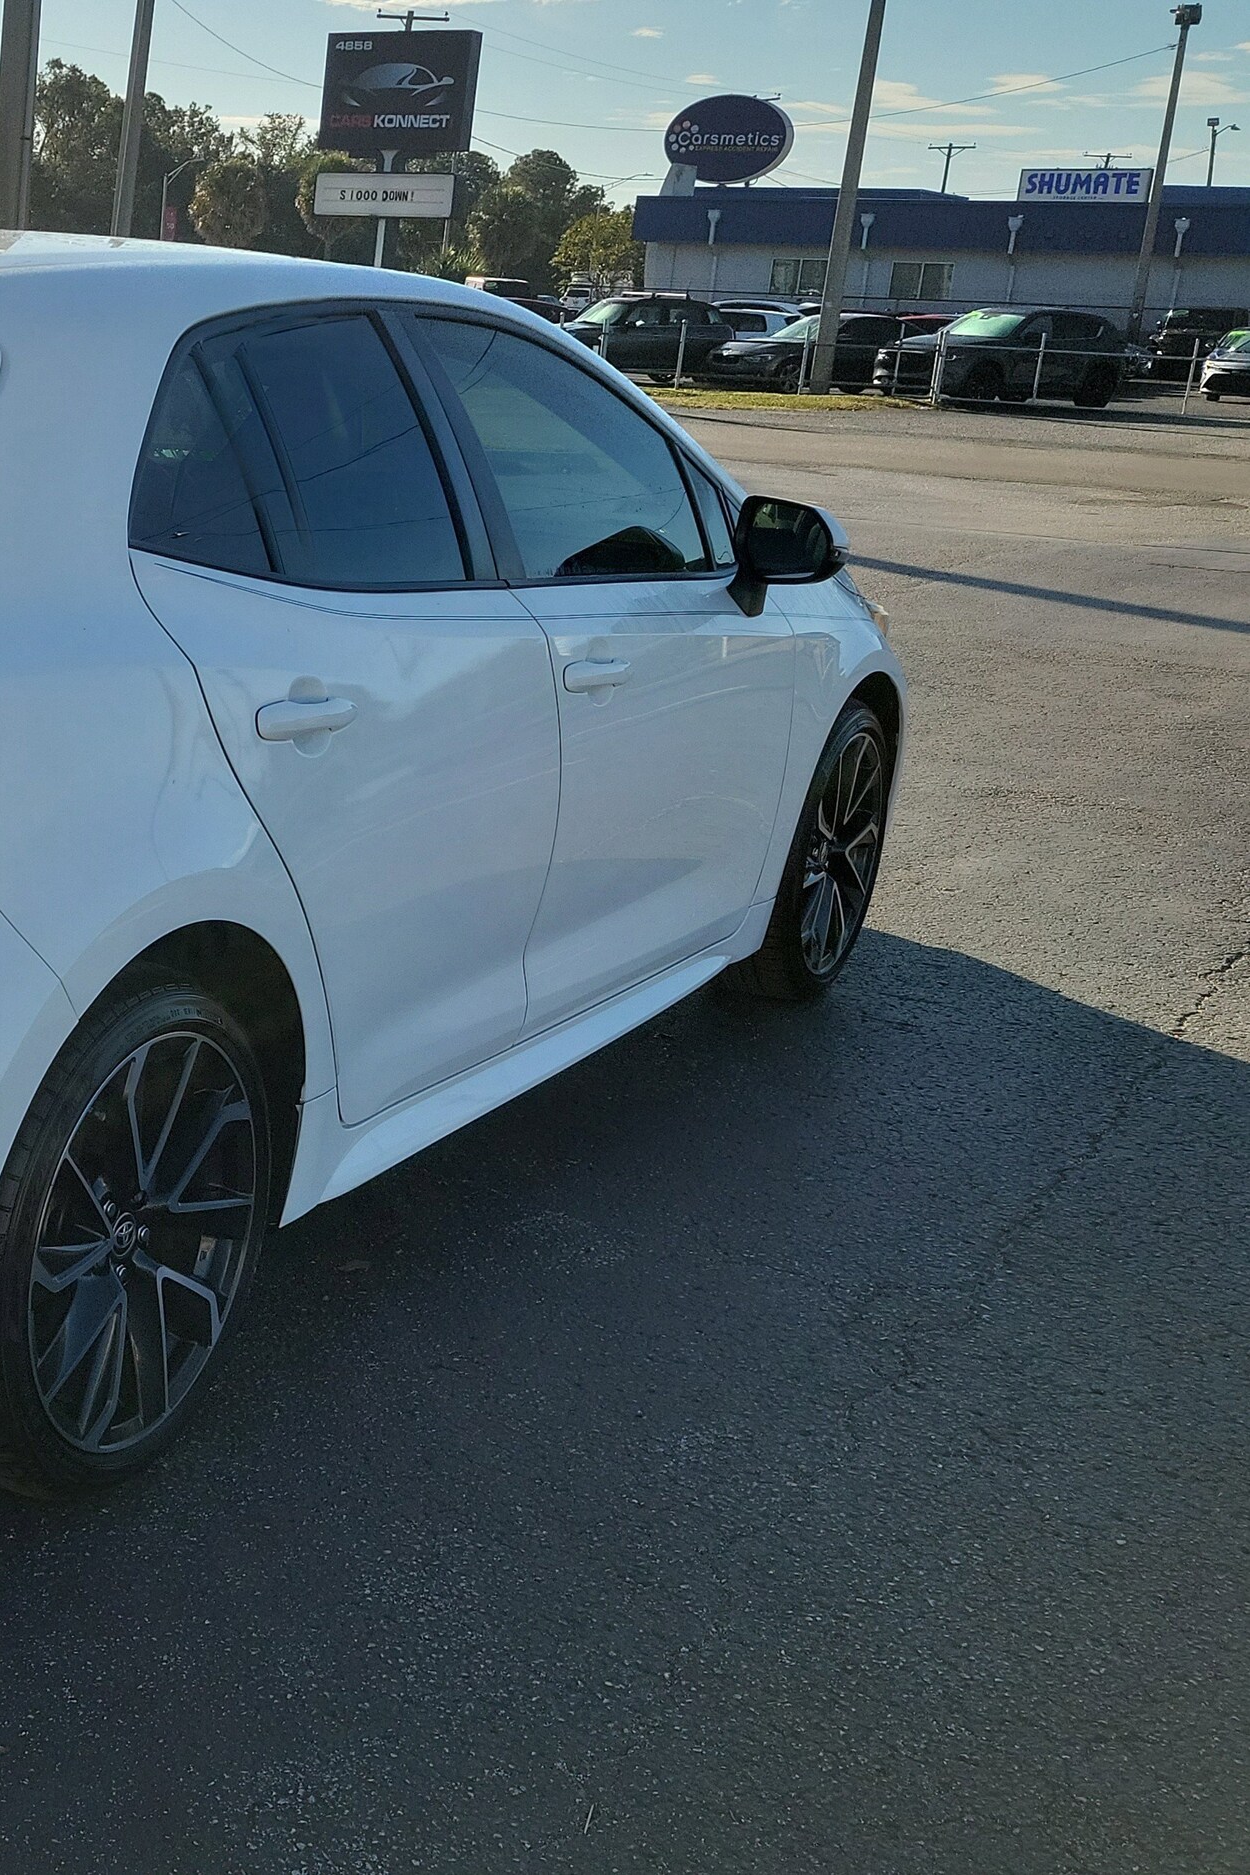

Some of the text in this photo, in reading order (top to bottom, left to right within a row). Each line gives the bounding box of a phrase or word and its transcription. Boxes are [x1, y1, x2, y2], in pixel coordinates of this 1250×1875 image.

[335, 40, 373, 51] 4858
[678, 131, 780, 146] Carsmetics
[1025, 172, 1141, 195] SHUMATE
[381, 190, 415, 202] DOWN!
